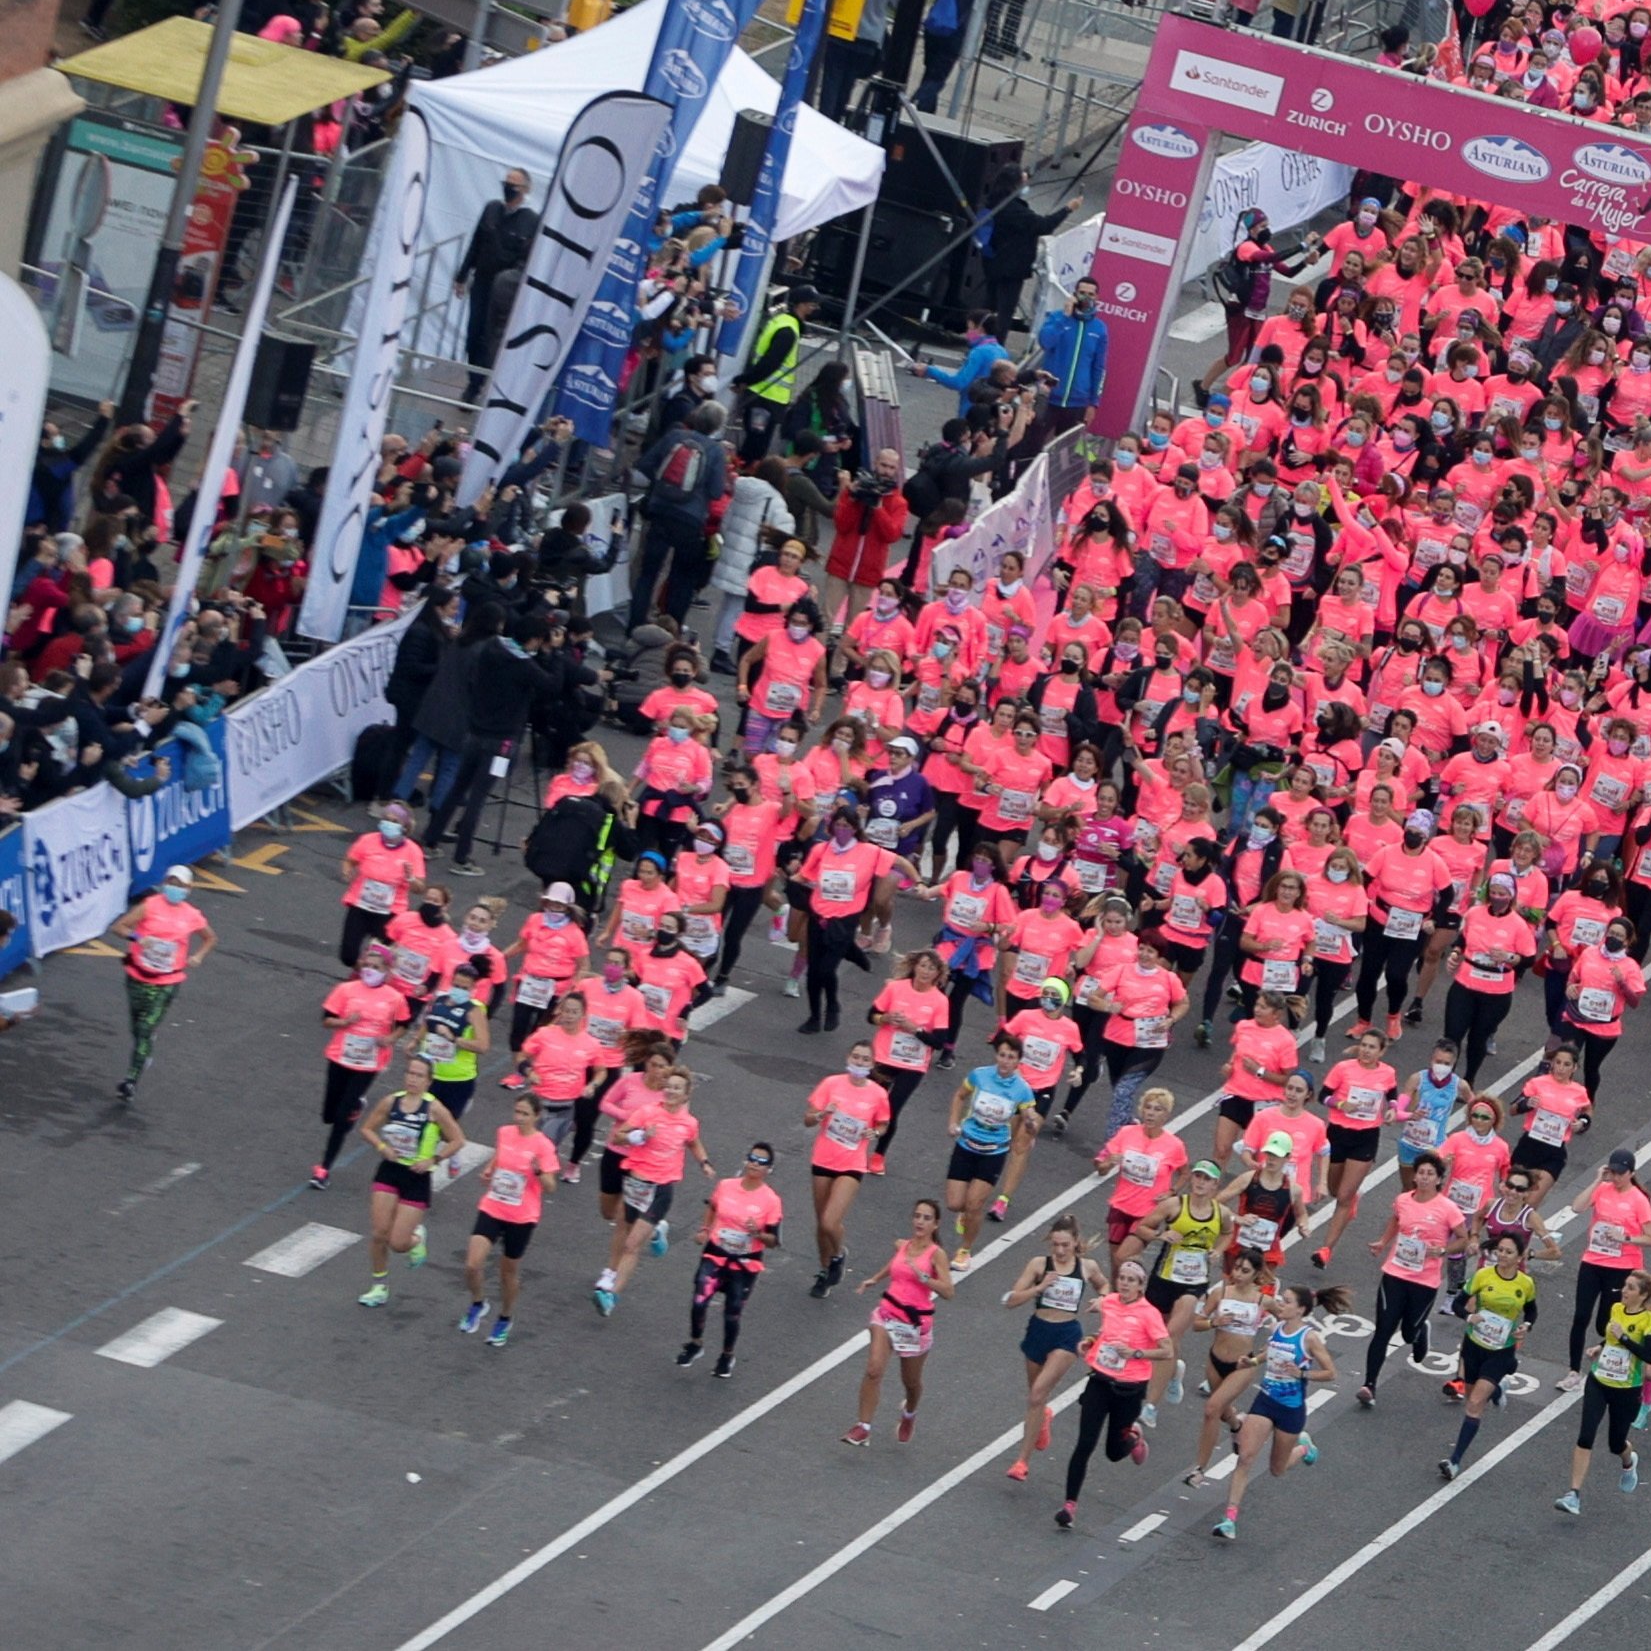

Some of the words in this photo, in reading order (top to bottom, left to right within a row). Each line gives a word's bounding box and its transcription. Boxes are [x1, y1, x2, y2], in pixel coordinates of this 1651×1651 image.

[1202, 71, 1270, 100] Santander
[1286, 110, 1347, 136] ZURICH
[1364, 114, 1451, 151] OYSHO
[1139, 131, 1194, 156] ASTURIANA
[1468, 144, 1542, 177] ASTURIANA
[1578, 150, 1646, 181] ASTURIANA
[1116, 178, 1187, 208] OYSHO
[1560, 169, 1626, 203] Carrera
[1571, 193, 1585, 207] de
[1586, 198, 1597, 210] la
[1590, 200, 1645, 233] Mujer
[1121, 236, 1166, 254] Santander
[1096, 301, 1147, 323] ZURICH
